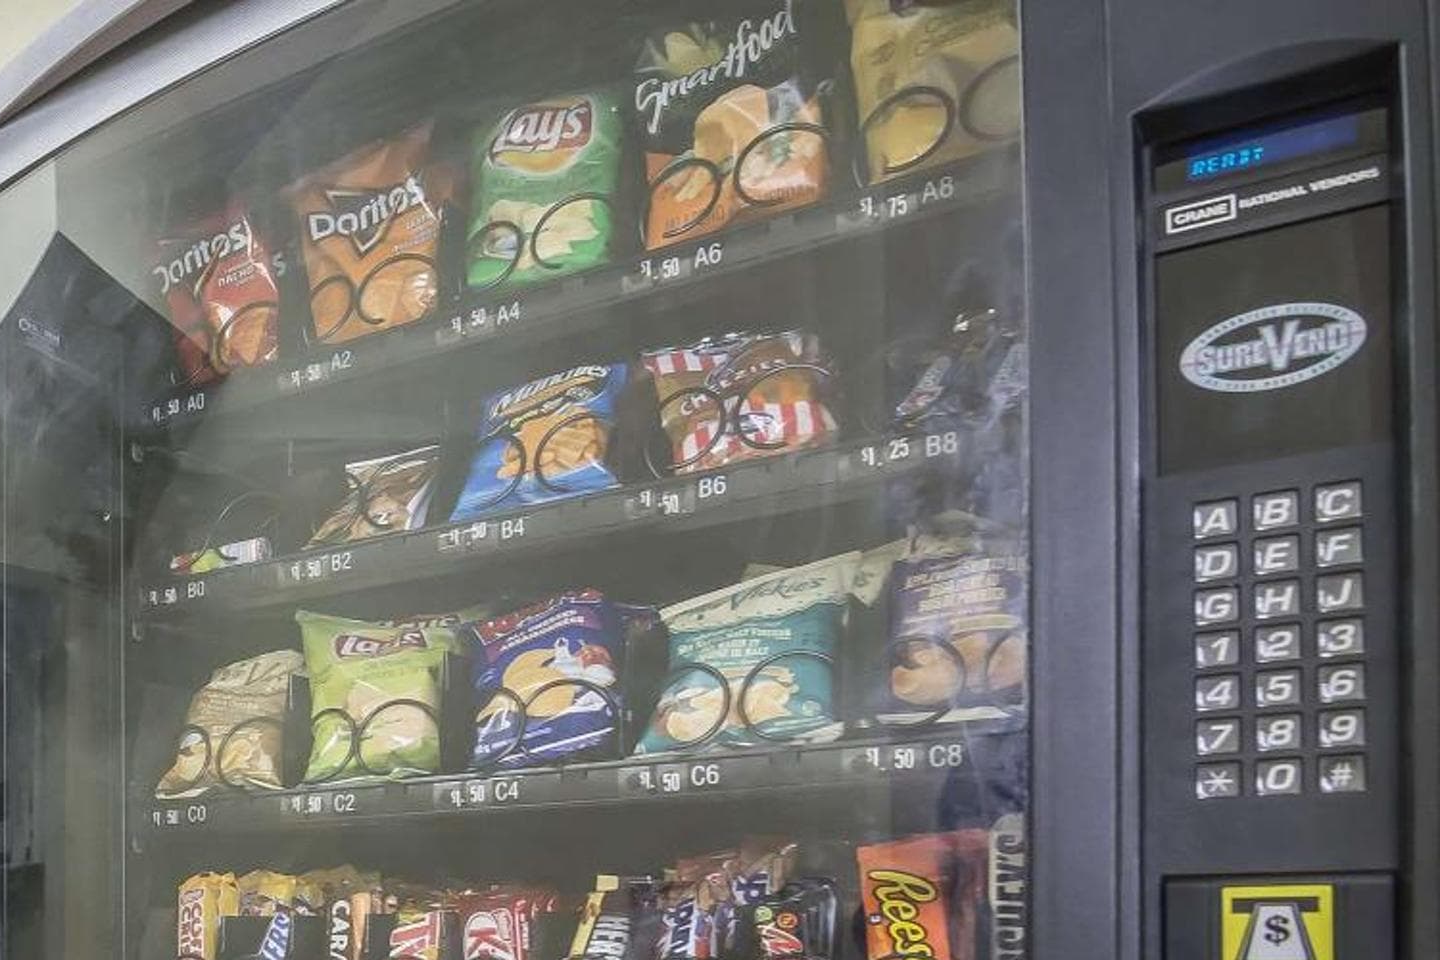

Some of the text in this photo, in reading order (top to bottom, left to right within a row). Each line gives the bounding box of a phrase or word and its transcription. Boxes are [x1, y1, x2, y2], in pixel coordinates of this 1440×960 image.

[636, 8, 796, 135] Smartfood
[921, 177, 954, 204] A8
[1173, 167, 1380, 225] CRANE NATIONAL VENDORS
[309, 176, 425, 241] Doritos
[694, 244, 721, 268] A6
[496, 302, 520, 326] A4
[331, 351, 351, 371] A2
[186, 394, 205, 412] A0
[925, 433, 957, 456] B8
[699, 476, 727, 498] B6
[1202, 489, 1353, 533] A B C
[501, 519, 525, 540] B4
[330, 553, 351, 571] B2
[1204, 534, 1352, 575] D E F
[187, 581, 205, 599] B0
[1204, 578, 1353, 619] G H J
[1210, 624, 1355, 662] 1 2 3
[1206, 669, 1356, 706] 4 5 6
[1211, 714, 1357, 749] 7 8 9
[929, 744, 961, 767] C8
[691, 764, 720, 786] C6
[1267, 763, 1295, 790] 0
[495, 780, 520, 800] C4
[187, 806, 207, 823] C0
[334, 794, 356, 812] C2
